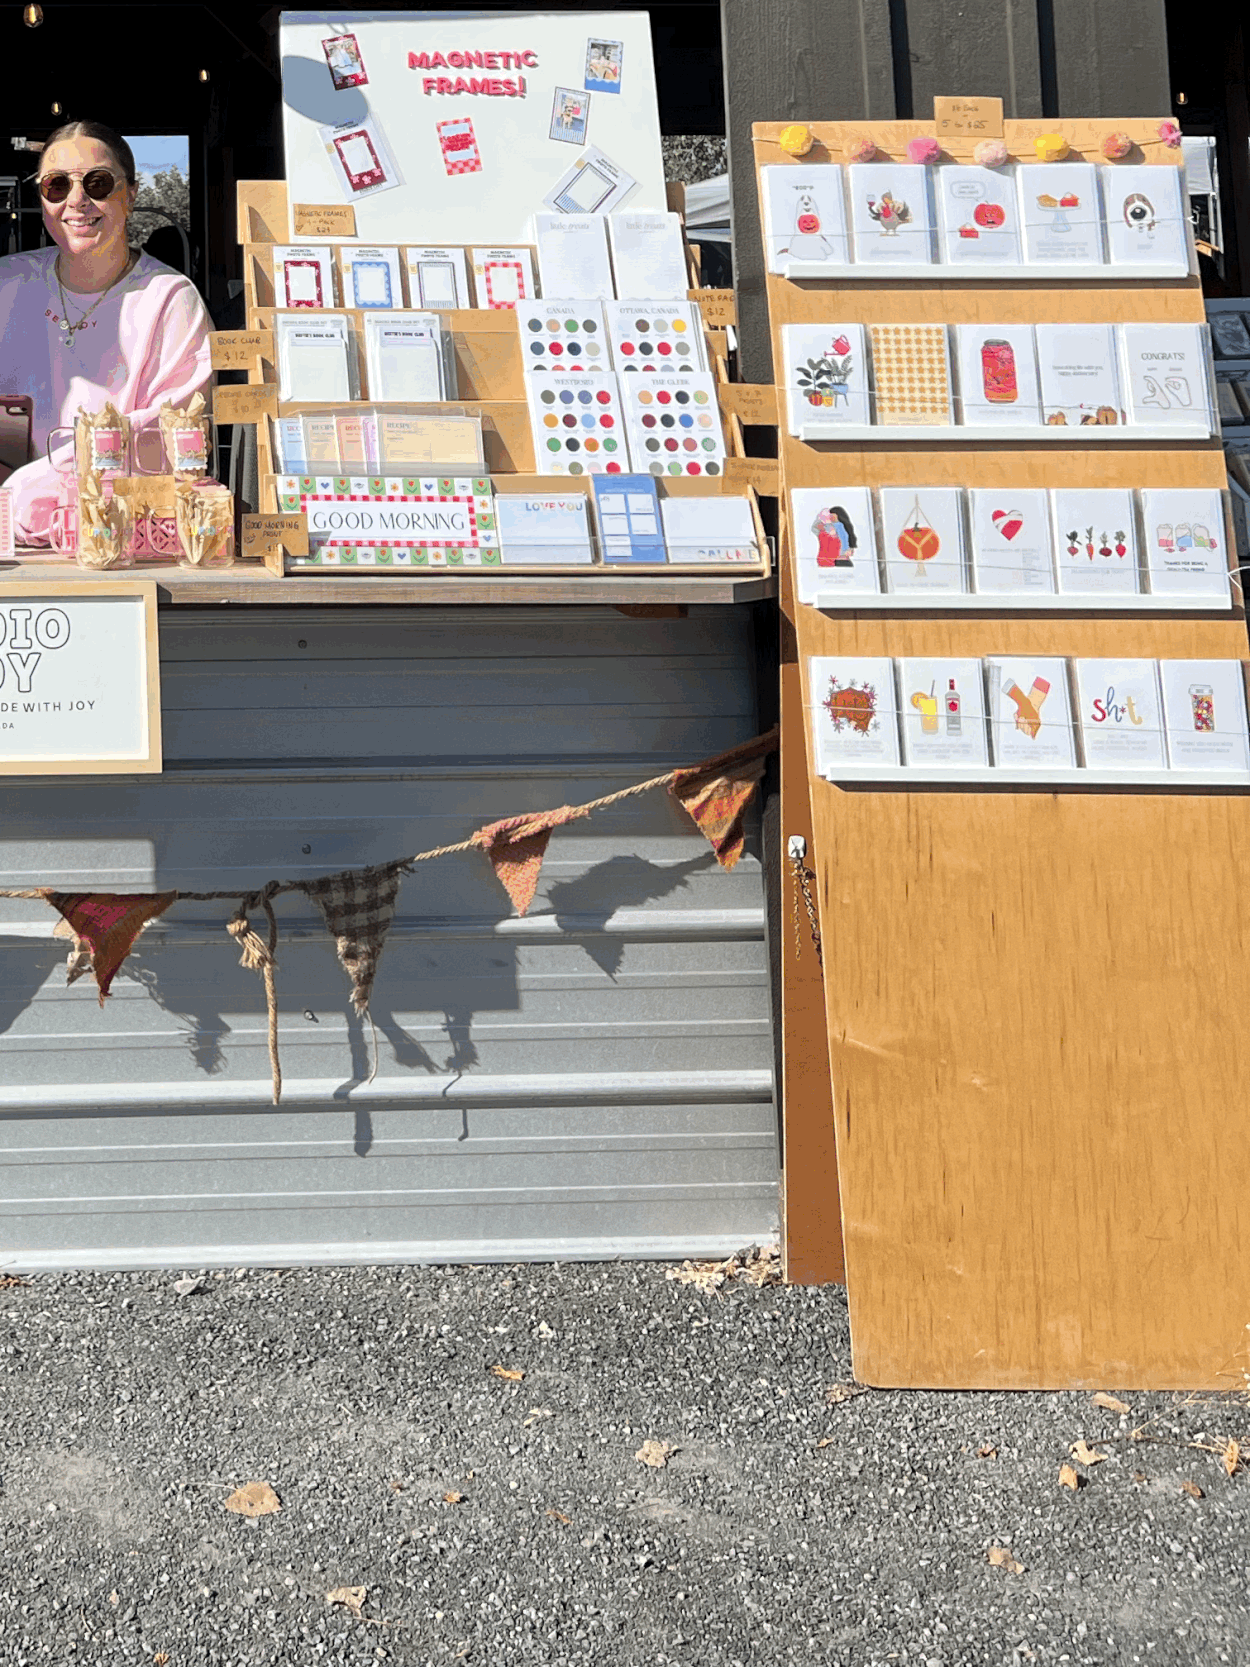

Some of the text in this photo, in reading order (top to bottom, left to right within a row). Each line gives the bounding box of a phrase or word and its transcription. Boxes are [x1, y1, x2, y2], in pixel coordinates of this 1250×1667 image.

[407, 50, 539, 70] MAGNETIC
[422, 75, 527, 99] FRAMES!
[546, 307, 575, 315] CANADA
[650, 307, 679, 315] CANADA
[706, 307, 725, 317] $12
[217, 337, 236, 345] BOOK
[1140, 352, 1185, 361] CONGRATS!
[525, 501, 583, 512] LOVE YOU
[244, 520, 300, 531] GOOD MORNING
[312, 510, 465, 531] GOOD MORNING
[22, 701, 62, 713] WITH
[68, 700, 96, 711] JOY
